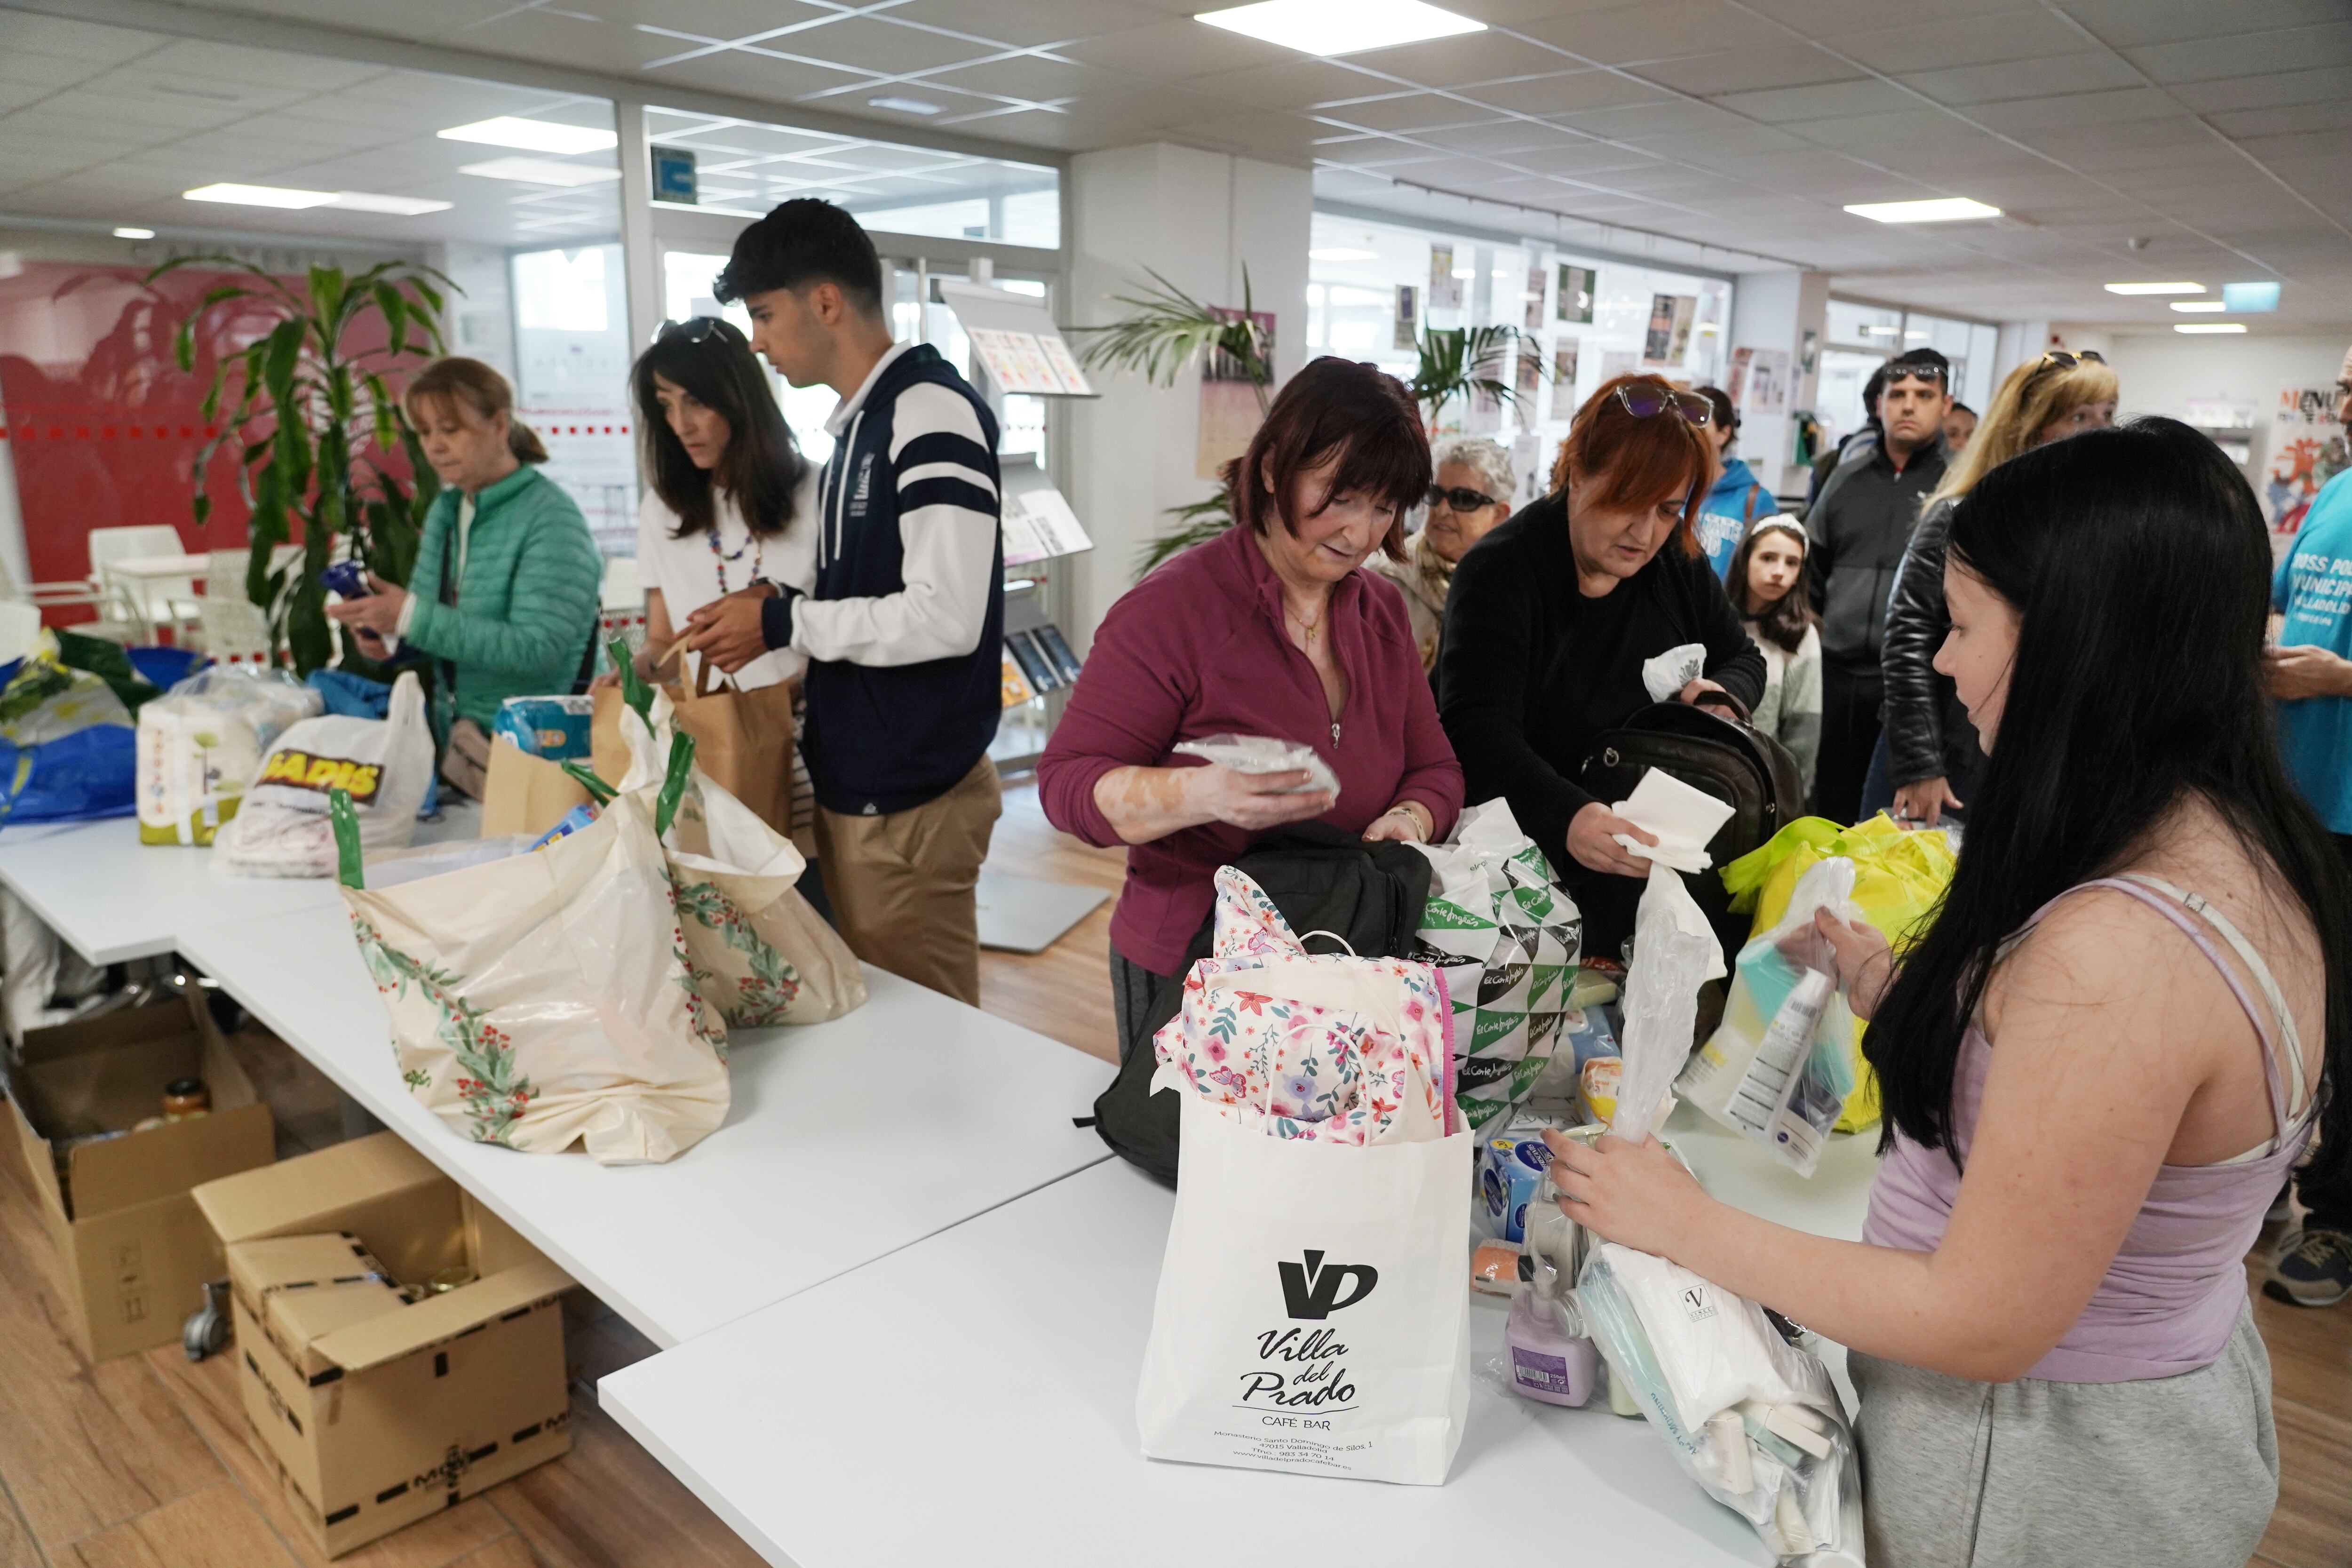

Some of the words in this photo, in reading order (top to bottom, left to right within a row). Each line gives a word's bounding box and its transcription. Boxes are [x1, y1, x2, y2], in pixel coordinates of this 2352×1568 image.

[1484, 976, 1492, 985] El
[1492, 975, 1510, 984] Corte
[1477, 1025, 1484, 1035] El
[1484, 1022, 1499, 1033] Corte
[1470, 1066, 1491, 1075] Corte
[1685, 1287, 1702, 1307] V
[1690, 1307, 1713, 1317] VINCC
[1257, 1327, 1349, 1361] Villa
[1293, 1361, 1334, 1385] del
[1240, 1368, 1355, 1406] Prado
[1262, 1416, 1297, 1427] CAFÉ
[1303, 1420, 1330, 1431] BAR
[1214, 1431, 1262, 1441] Monasterio
[1291, 1438, 1330, 1449] Domingo
[1251, 1447, 1276, 1456] Tfno.:
[1287, 1444, 1327, 1453] Valladolid
[1233, 1451, 1351, 1470] www.villadelpradocafebar.es
